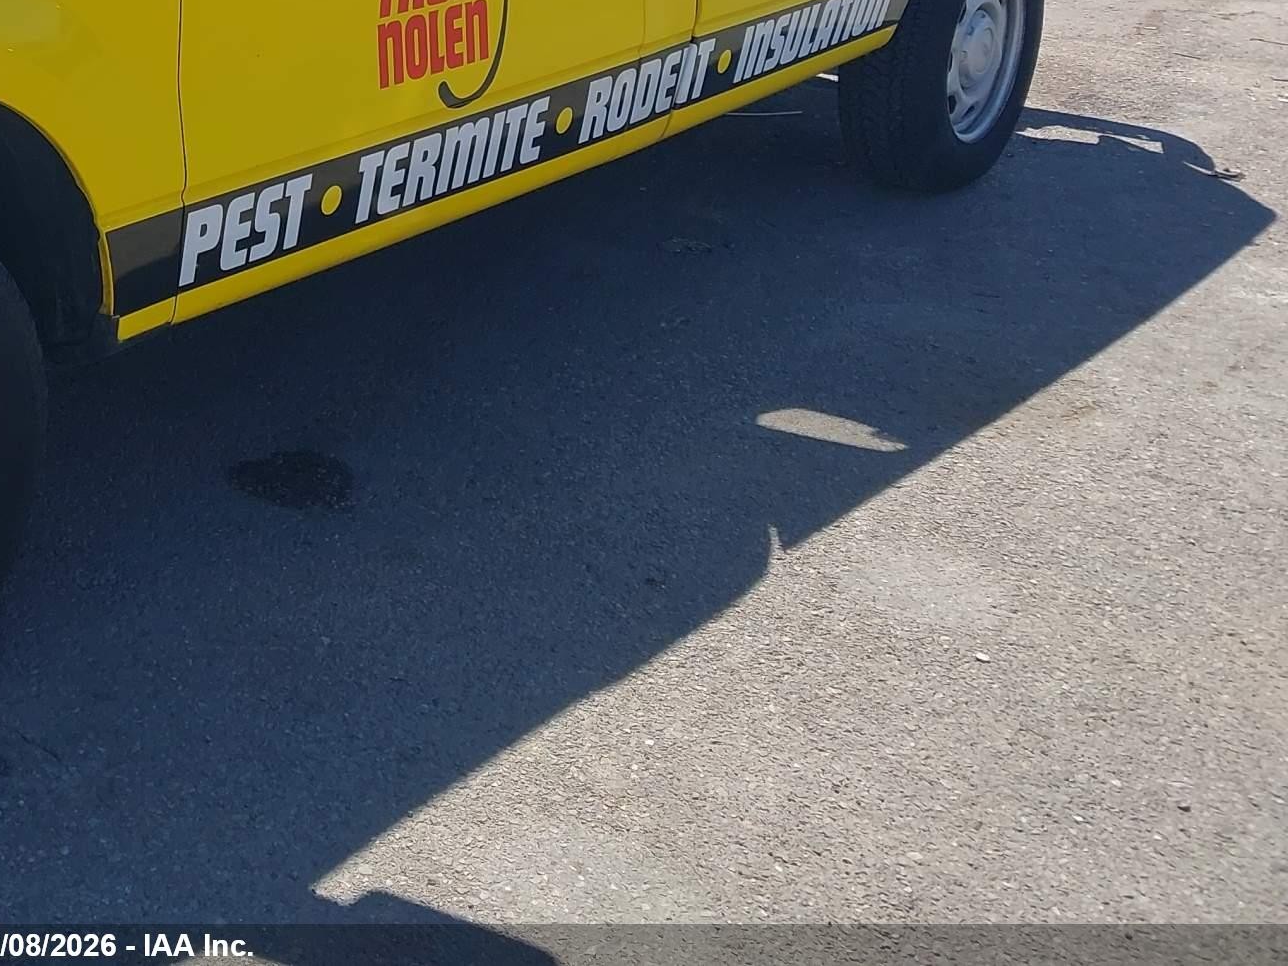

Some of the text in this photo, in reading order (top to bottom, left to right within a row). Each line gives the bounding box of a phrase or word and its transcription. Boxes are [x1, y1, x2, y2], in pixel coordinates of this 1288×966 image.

[178, 172, 313, 287] PEST
[354, 95, 551, 224] TERMITE
[578, 37, 717, 145] RODENT
